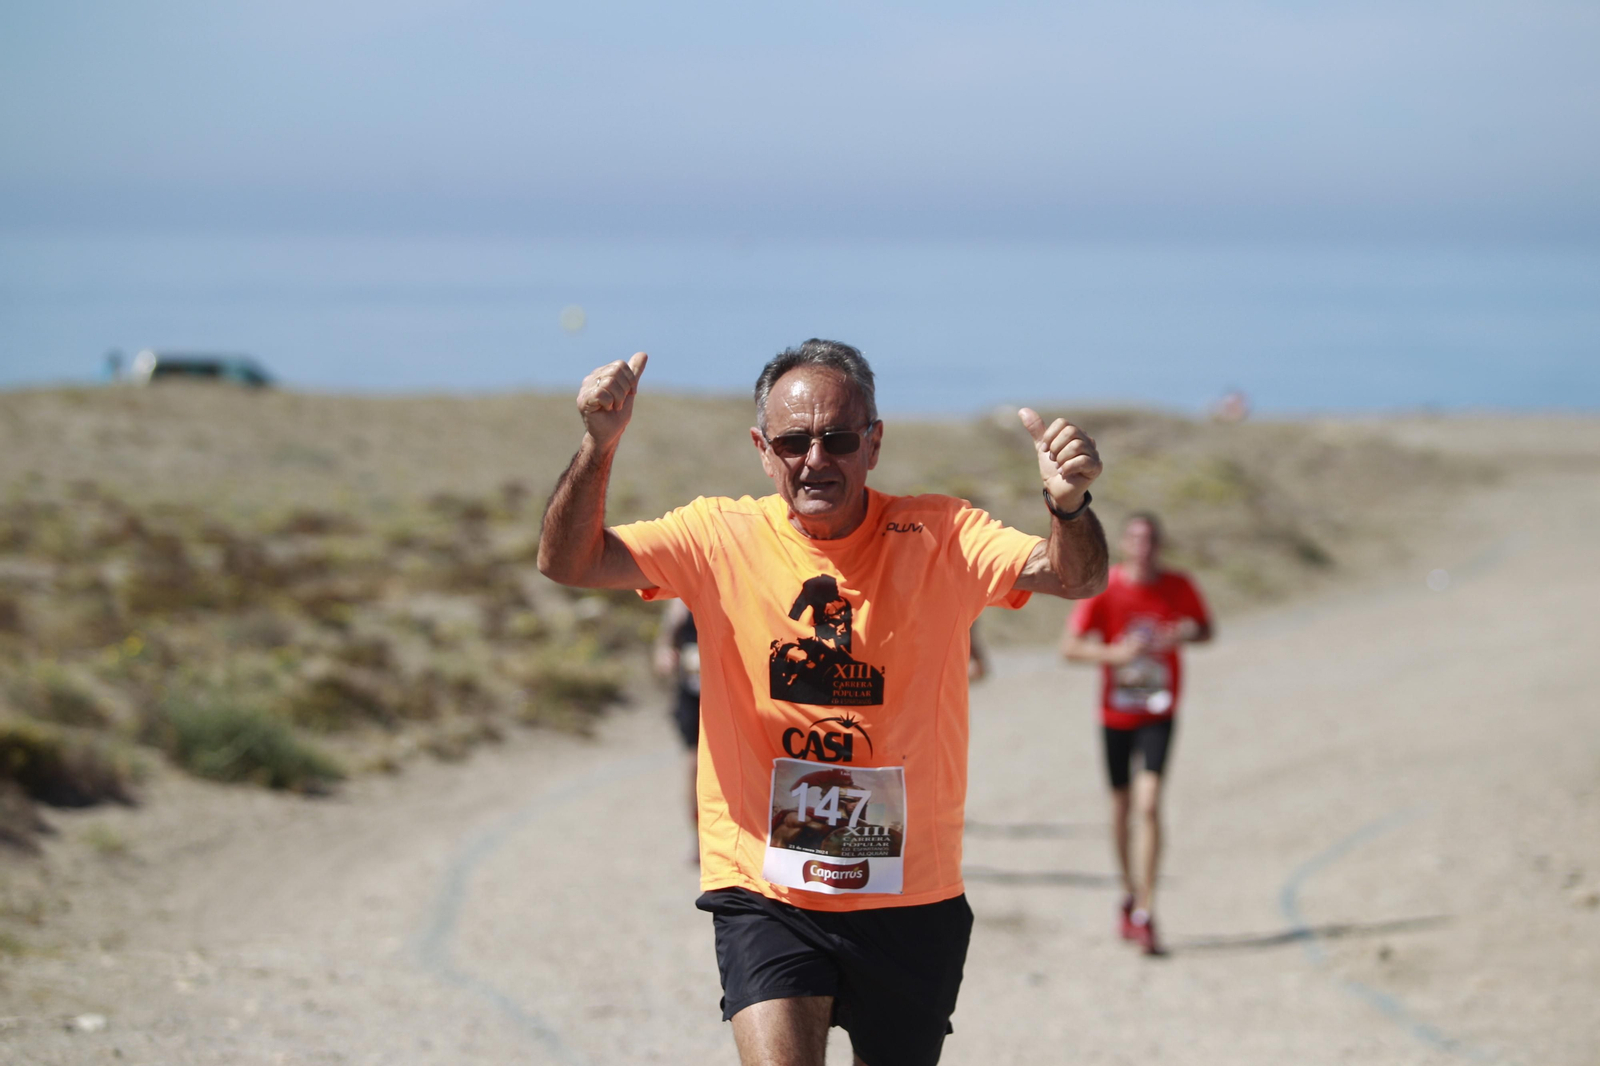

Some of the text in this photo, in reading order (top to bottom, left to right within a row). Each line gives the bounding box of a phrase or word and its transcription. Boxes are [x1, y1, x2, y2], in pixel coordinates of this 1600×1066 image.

[833, 663, 872, 679] XIII
[782, 727, 853, 762] CASI
[791, 782, 872, 827] 147
[843, 827, 891, 836] XIII
